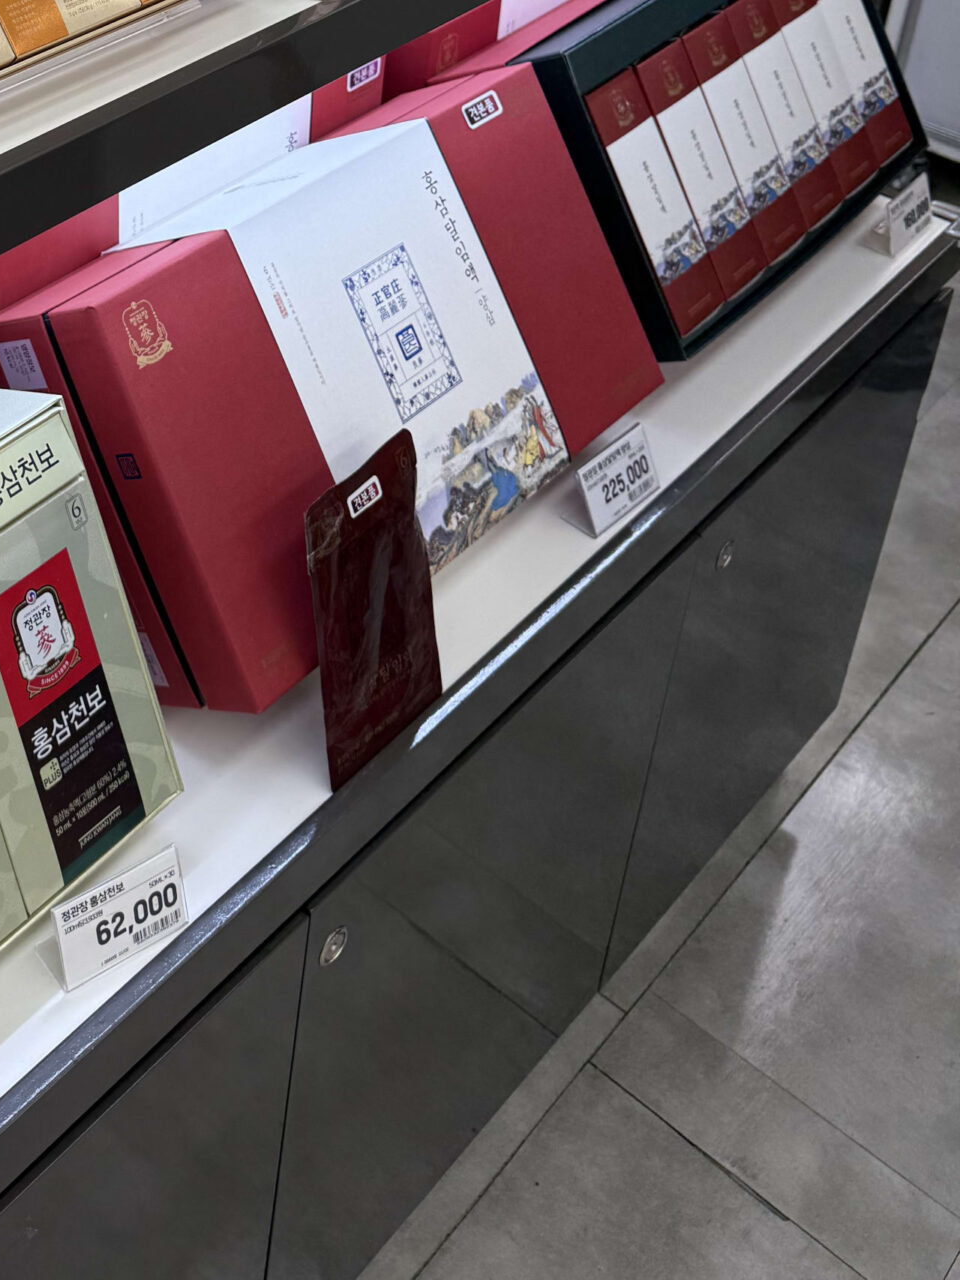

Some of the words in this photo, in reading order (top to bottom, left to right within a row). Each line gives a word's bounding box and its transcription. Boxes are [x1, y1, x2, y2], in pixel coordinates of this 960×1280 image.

[468, 95, 496, 122] 견본품
[352, 481, 379, 512] 견본품
[602, 453, 649, 505] 225,000
[22, 603, 52, 632] 정관장
[31, 683, 107, 760] 홍삼천보
[43, 768, 62, 788] PLUS
[61, 900, 89, 923] 정관장
[89, 881, 126, 907] 홍삼천보
[95, 881, 178, 946] 62,000
